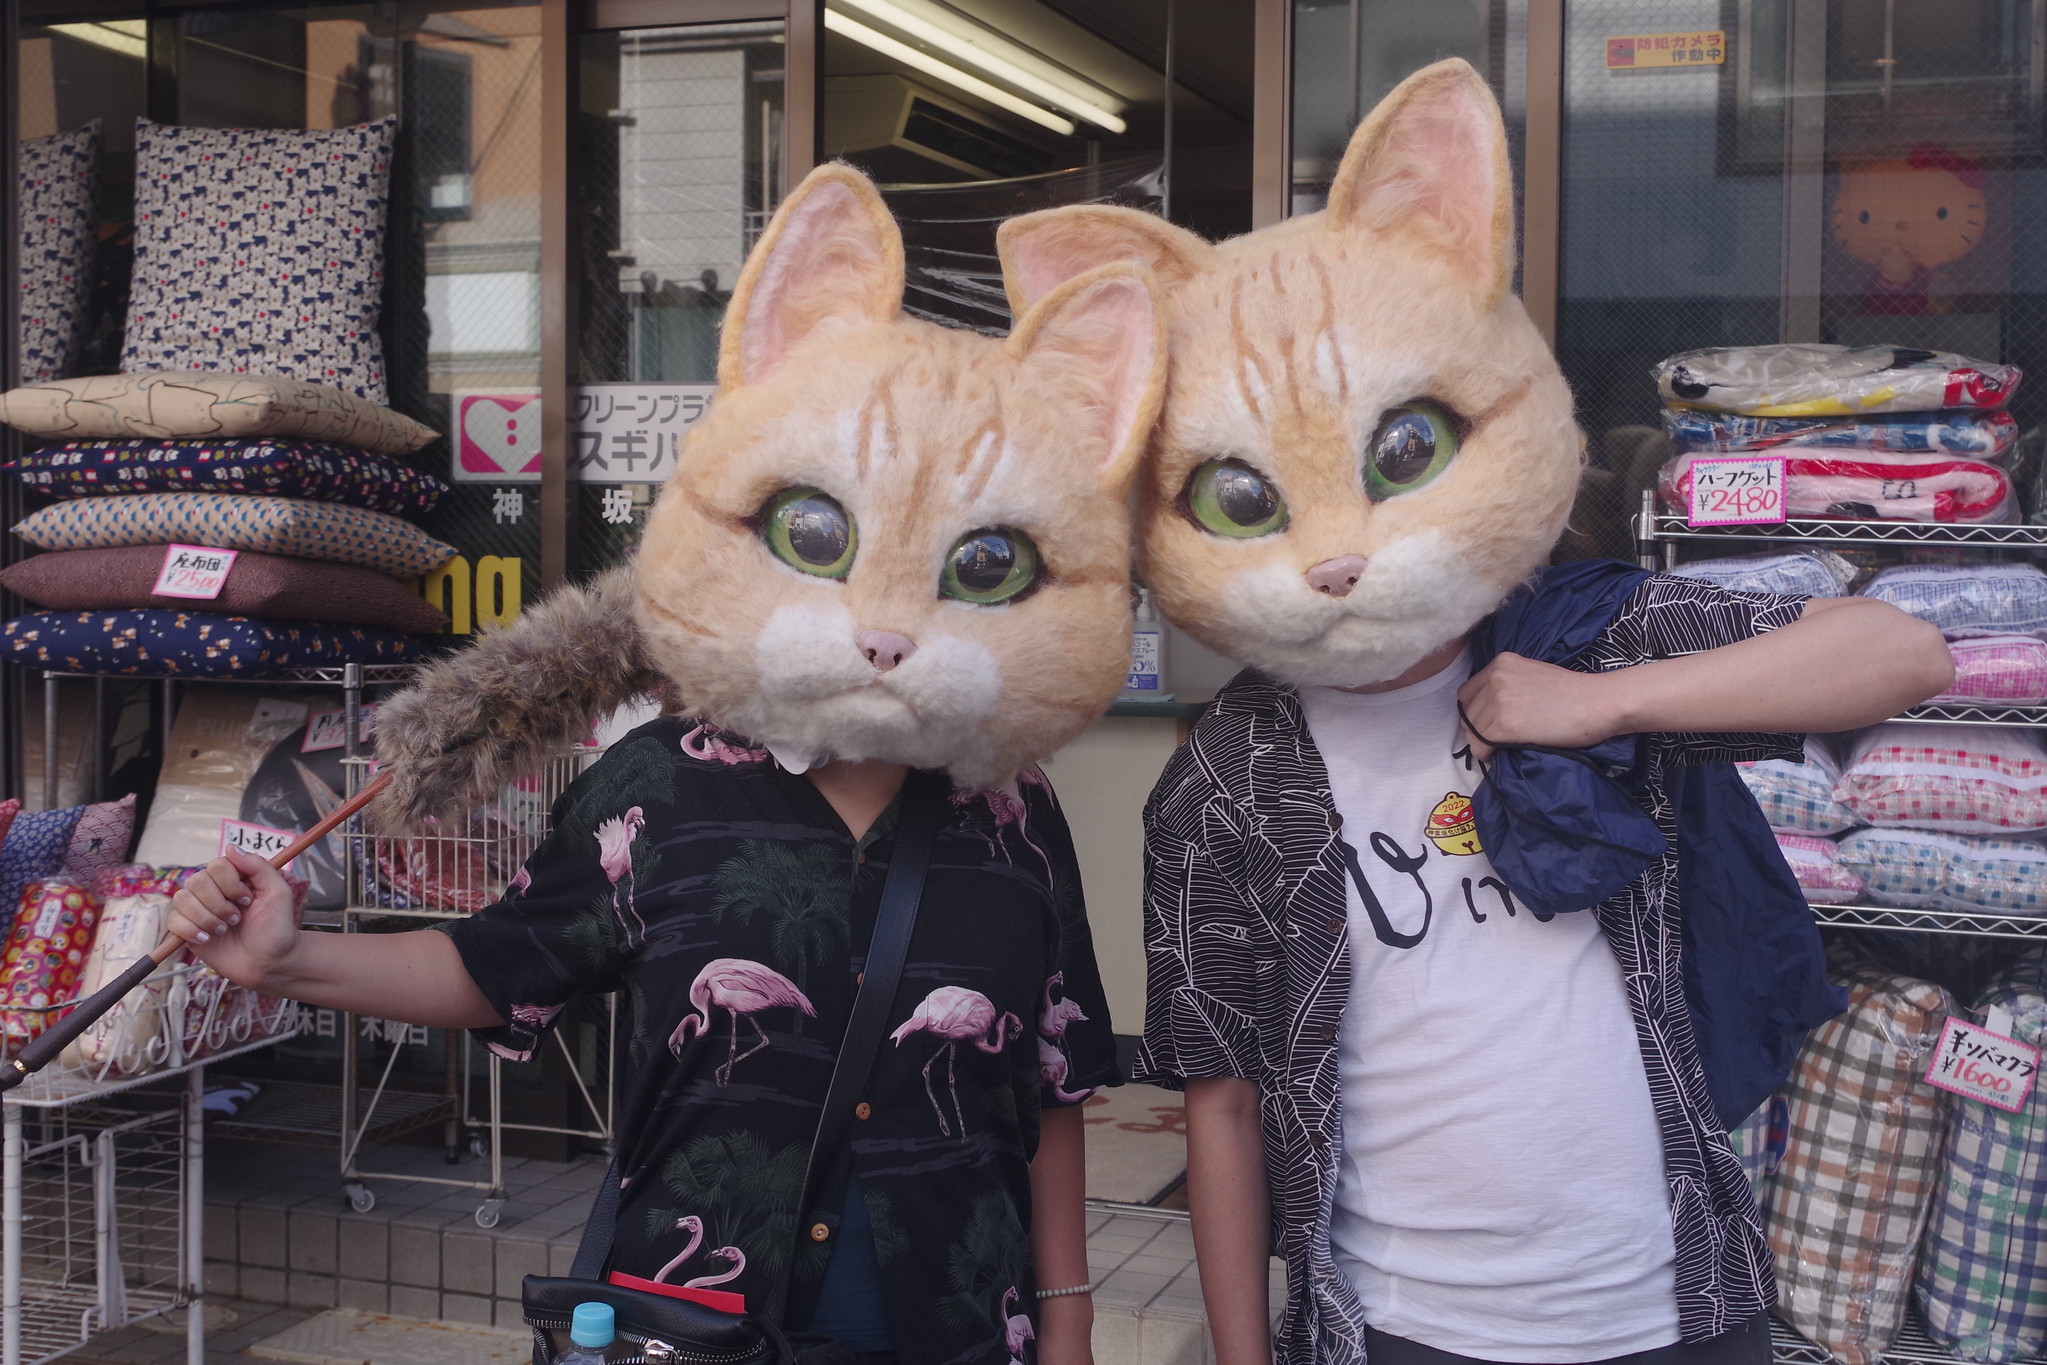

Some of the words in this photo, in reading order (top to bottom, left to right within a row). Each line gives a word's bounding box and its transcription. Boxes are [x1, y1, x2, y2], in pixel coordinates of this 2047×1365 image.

[1636, 34, 1720, 51] 防犯カメラ
[1671, 48, 1721, 62] 作動中
[572, 394, 712, 424] クリーンプラ
[1697, 468, 1778, 487] ハーフケット
[1698, 486, 1779, 517] ¥2480
[1442, 800, 1466, 813] 2022
[232, 828, 287, 852] 小まくら
[1940, 1055, 2013, 1093] ¥1600
